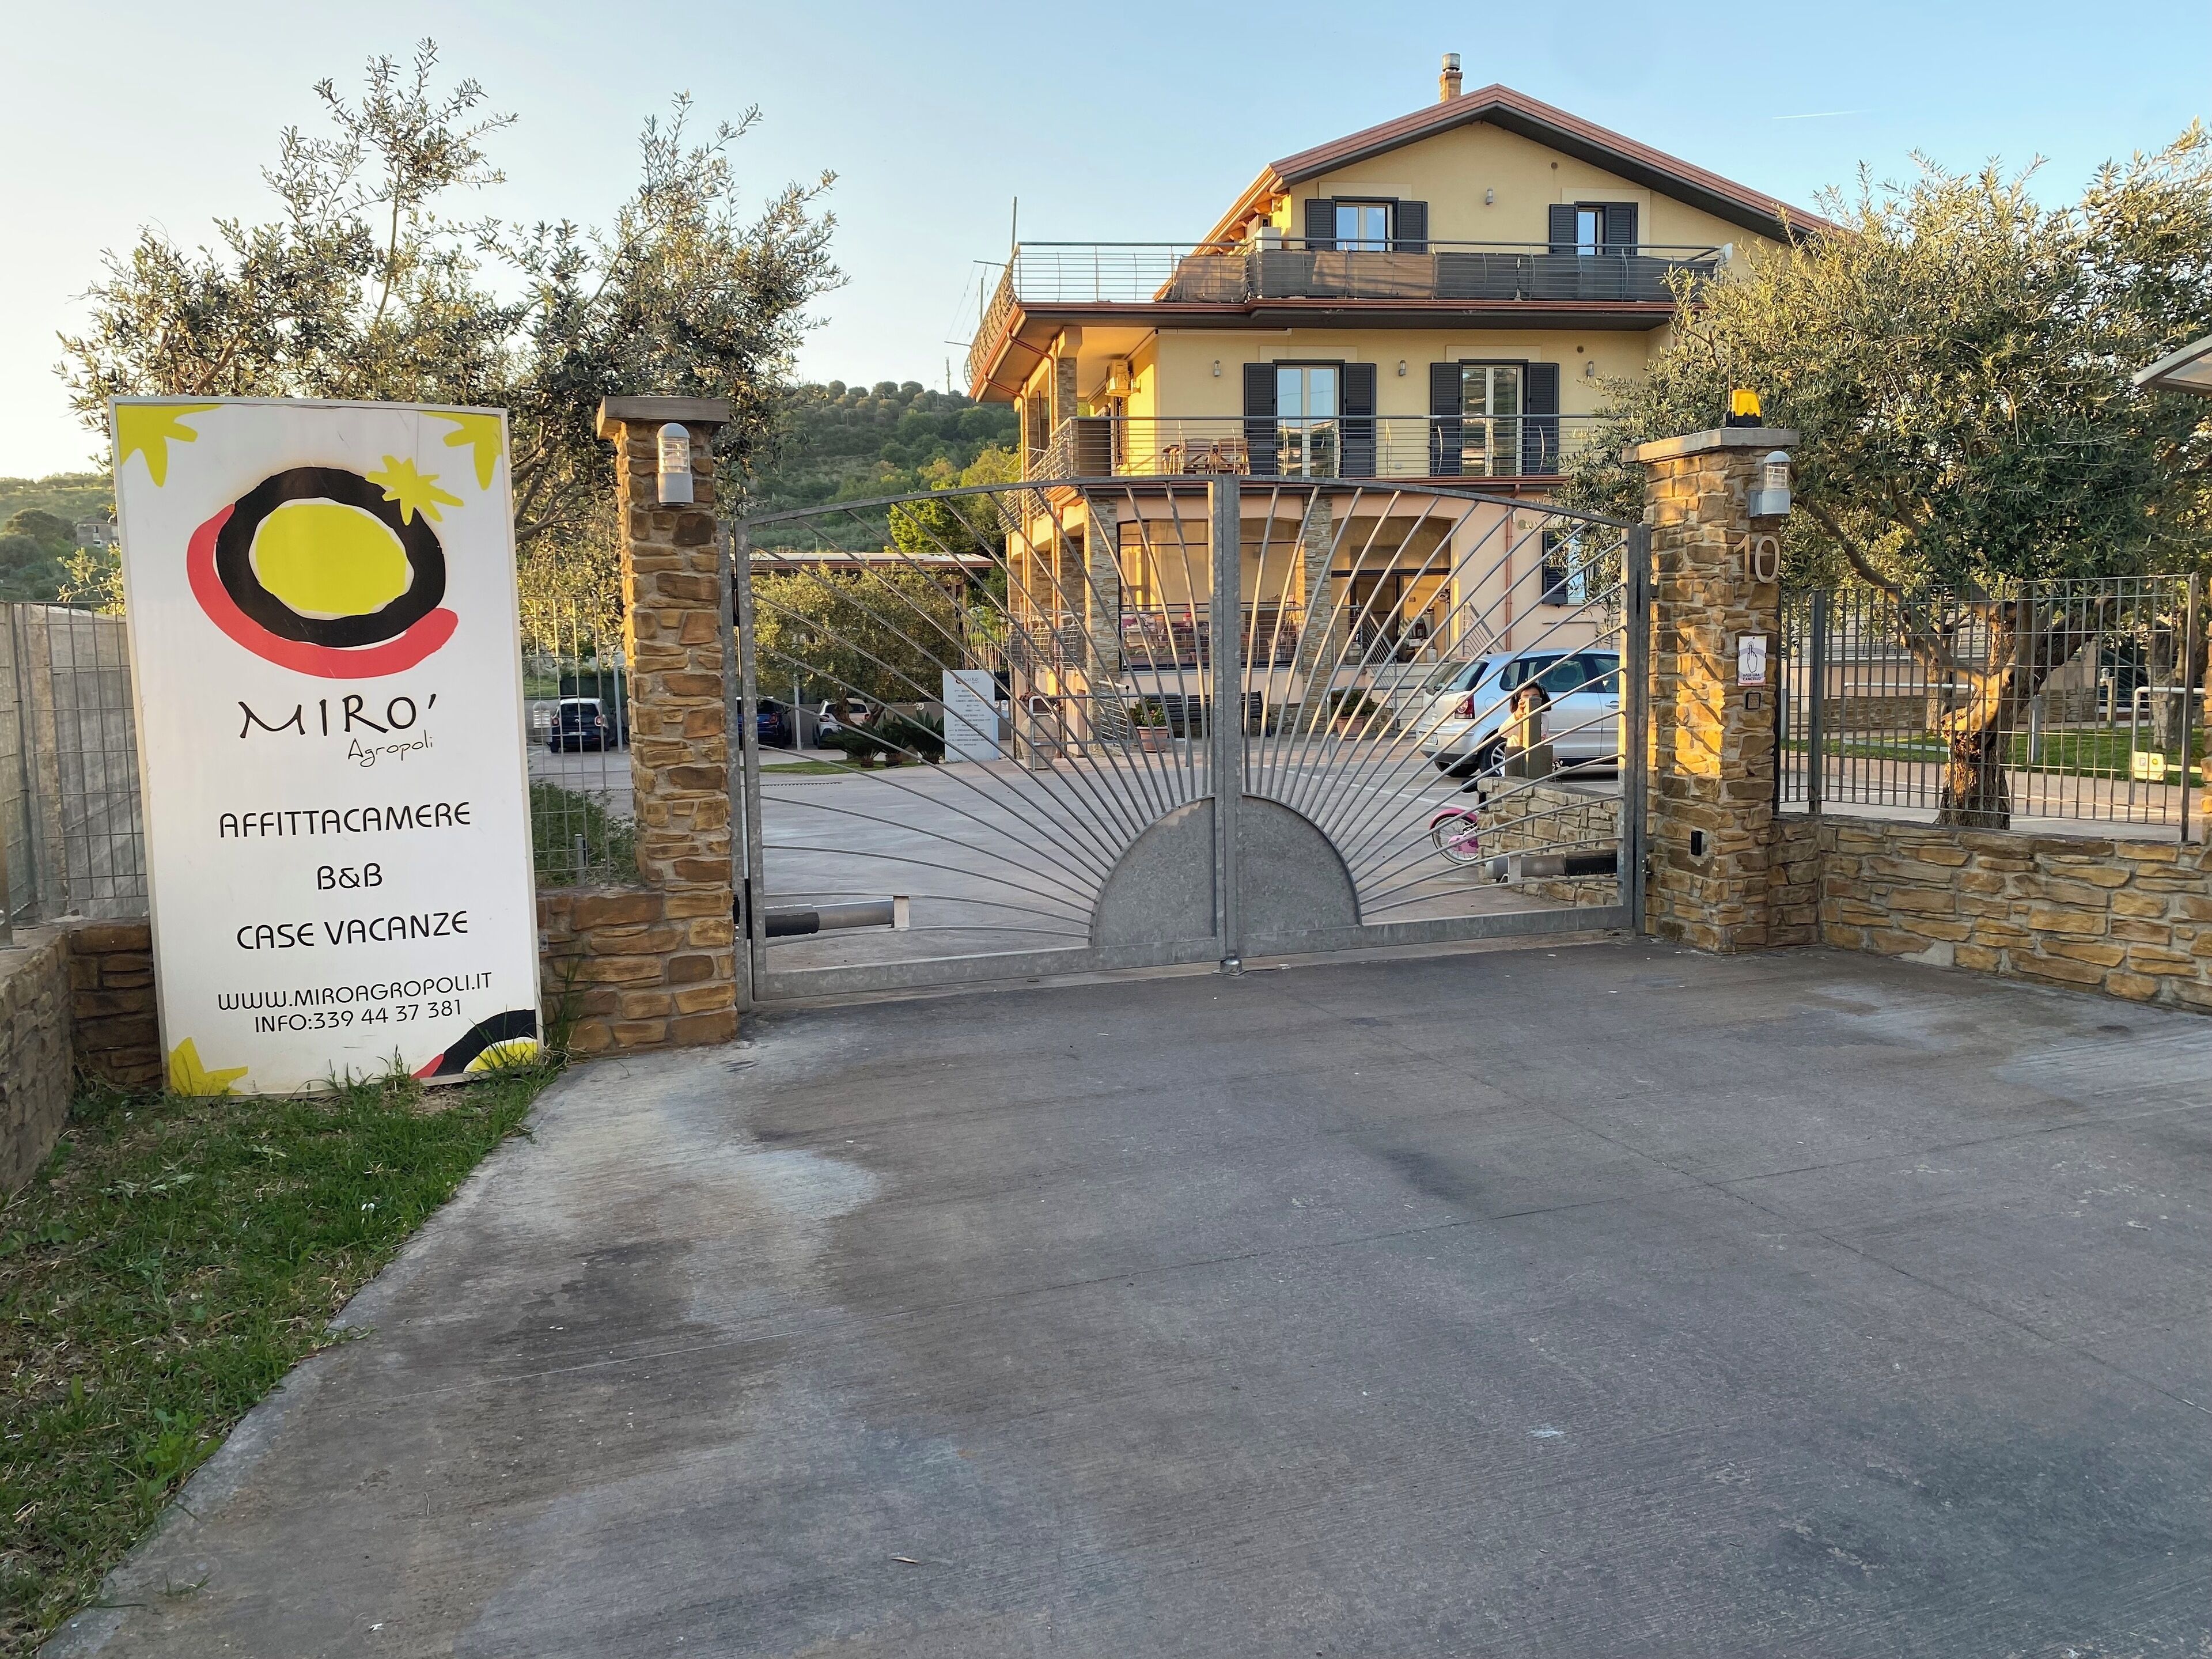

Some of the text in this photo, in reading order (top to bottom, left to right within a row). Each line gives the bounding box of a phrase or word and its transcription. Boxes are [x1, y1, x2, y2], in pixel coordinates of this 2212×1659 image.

[1733, 534, 1779, 584] 10
[238, 694, 437, 738] MIRO'
[347, 730, 434, 767] Agropoli
[219, 801, 471, 838] AFFITTACAMERE
[317, 862, 382, 890] B&B
[237, 910, 468, 950] CASE VACANZE
[218, 972, 492, 1010] WWW.MIROAGROPOLI.IT
[255, 999, 461, 1033] INFO:339 44 37 381
